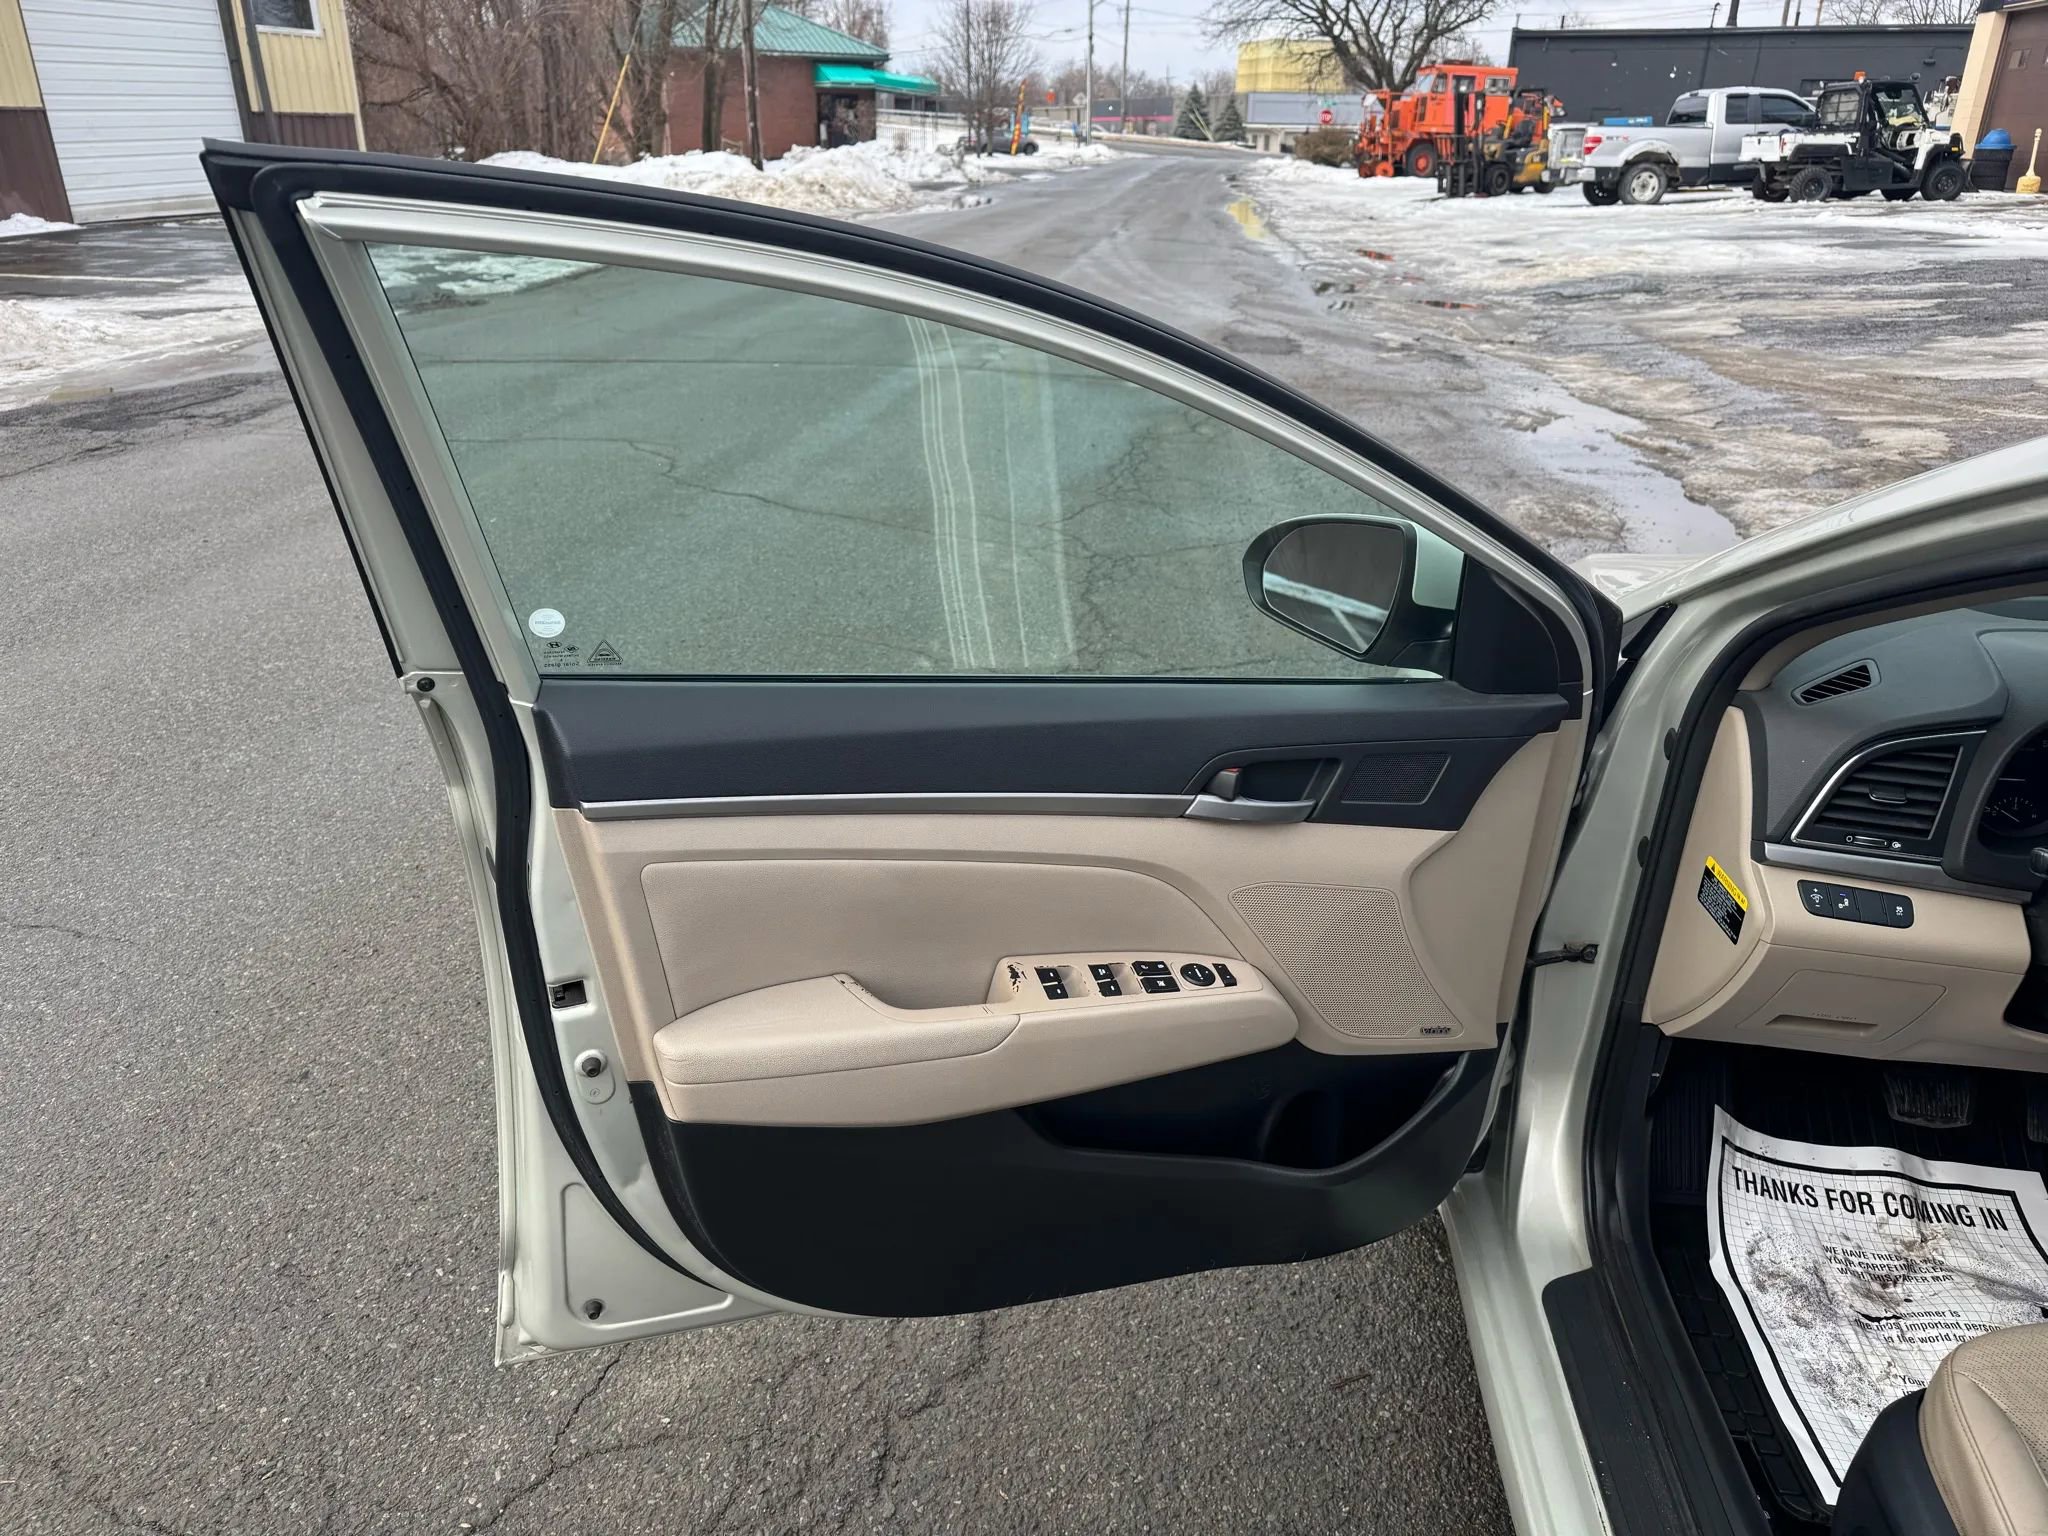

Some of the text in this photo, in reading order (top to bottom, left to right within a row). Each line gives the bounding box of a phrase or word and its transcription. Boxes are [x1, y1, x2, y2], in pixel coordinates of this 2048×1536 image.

[1731, 1165, 2009, 1232] THANKS FOR COMING IN
[1822, 1245, 1839, 1255] WE
[1841, 1249, 1869, 1260] HAVE
[1870, 1253, 1903, 1262] TRIED
[1827, 1255, 1856, 1268] YOUR
[1858, 1261, 1917, 1274] CARPETING
[1867, 1273, 1893, 1282] THIS
[1895, 1274, 1930, 1283] PAPER
[1931, 1274, 1955, 1283] MAT
[1949, 1309, 1961, 1318] is
[1904, 1321, 1963, 1332] important
[1897, 1334, 1916, 1344] the
[1919, 1332, 1953, 1344] world
[1953, 1333, 1966, 1343] to
[1898, 1375, 1926, 1387] Your
